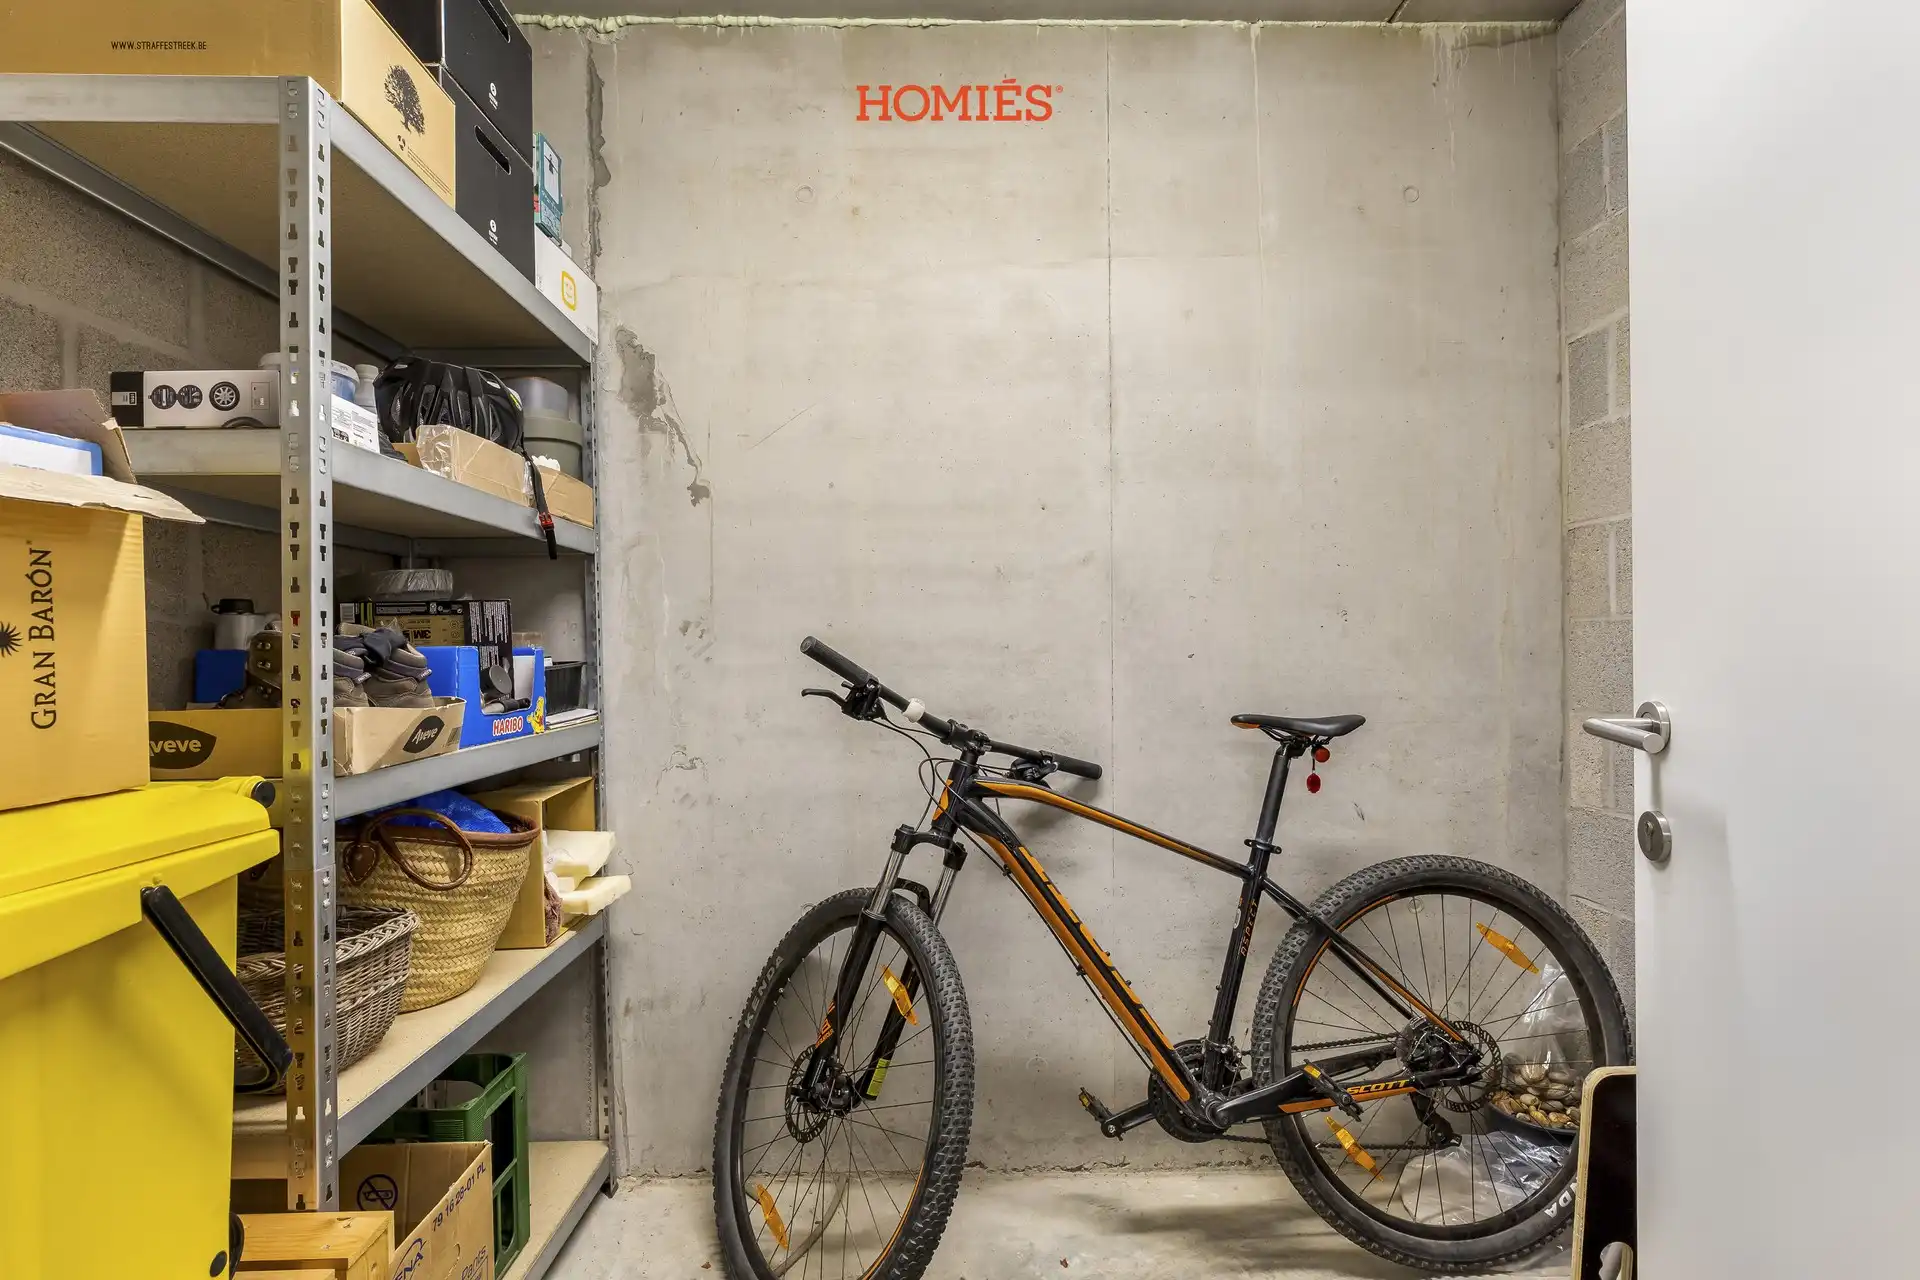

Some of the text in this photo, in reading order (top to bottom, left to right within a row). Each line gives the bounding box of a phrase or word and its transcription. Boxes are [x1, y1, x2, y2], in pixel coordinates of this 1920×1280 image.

[110, 41, 207, 50] WWW.STRAFFESTREEK.BE
[25, 547, 57, 729] GRAN BARÓN
[493, 716, 523, 736] HARIBO
[149, 739, 202, 757] veve
[744, 956, 784, 1029] KENDA
[1346, 1079, 1410, 1095] SCOTT
[432, 1212, 443, 1232] 79
[445, 1199, 454, 1216] 16
[476, 1161, 486, 1179] PL
